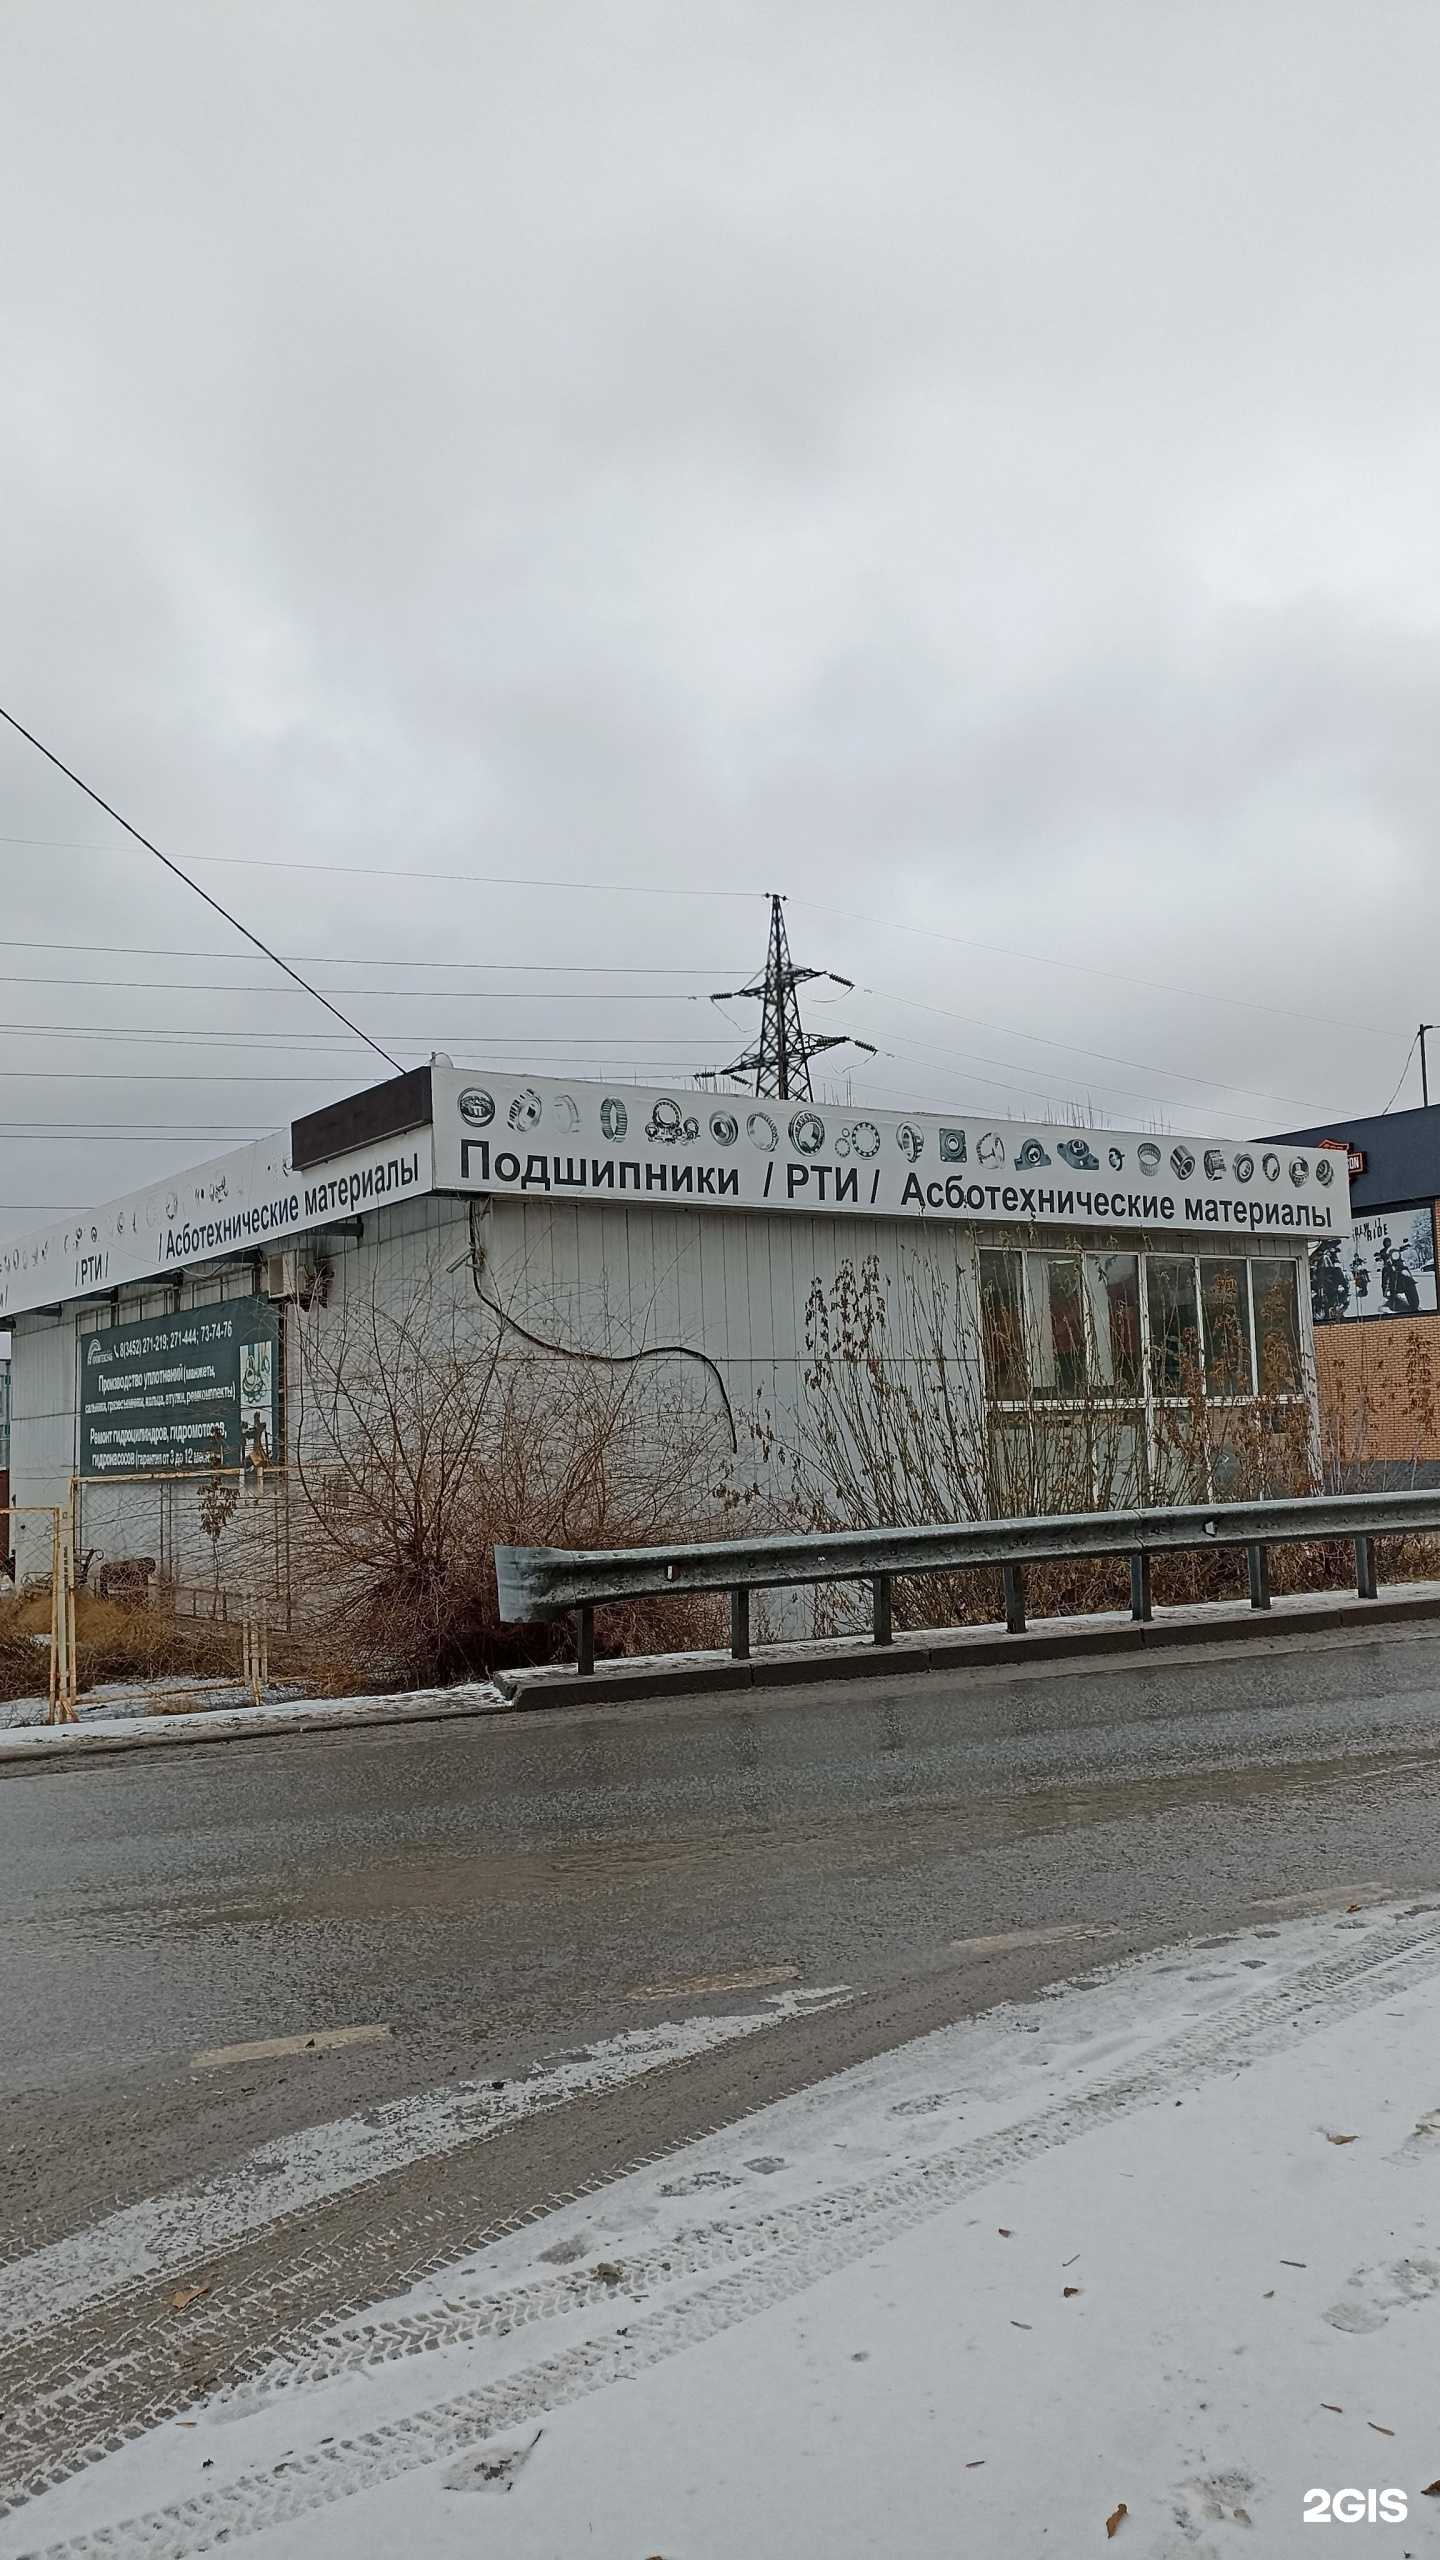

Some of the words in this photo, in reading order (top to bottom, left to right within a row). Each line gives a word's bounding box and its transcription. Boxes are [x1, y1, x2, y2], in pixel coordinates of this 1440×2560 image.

[459, 1138, 740, 1197] Подшипники
[762, 1160, 774, 1198] /
[786, 1163, 859, 1204] РТИ
[869, 1168, 881, 1204] /
[901, 1172, 1175, 1219] Асботехнические
[1185, 1196, 1333, 1230] материалы
[81, 1253, 103, 1285] РТИ
[165, 1193, 299, 1261] Асботехнические
[305, 1152, 420, 1217] материалы
[1367, 1224, 1388, 1241] RIDE
[142, 1334, 169, 1354] 271-219;
[170, 1327, 199, 1349] 271-444;
[200, 1320, 233, 1342] 73-74-76
[98, 1373, 143, 1396] Производство
[143, 1363, 183, 1391] уплотнений
[90, 1427, 112, 1445] Ремонт
[169, 1449, 175, 1465] 3
[184, 1447, 193, 1464] 12
